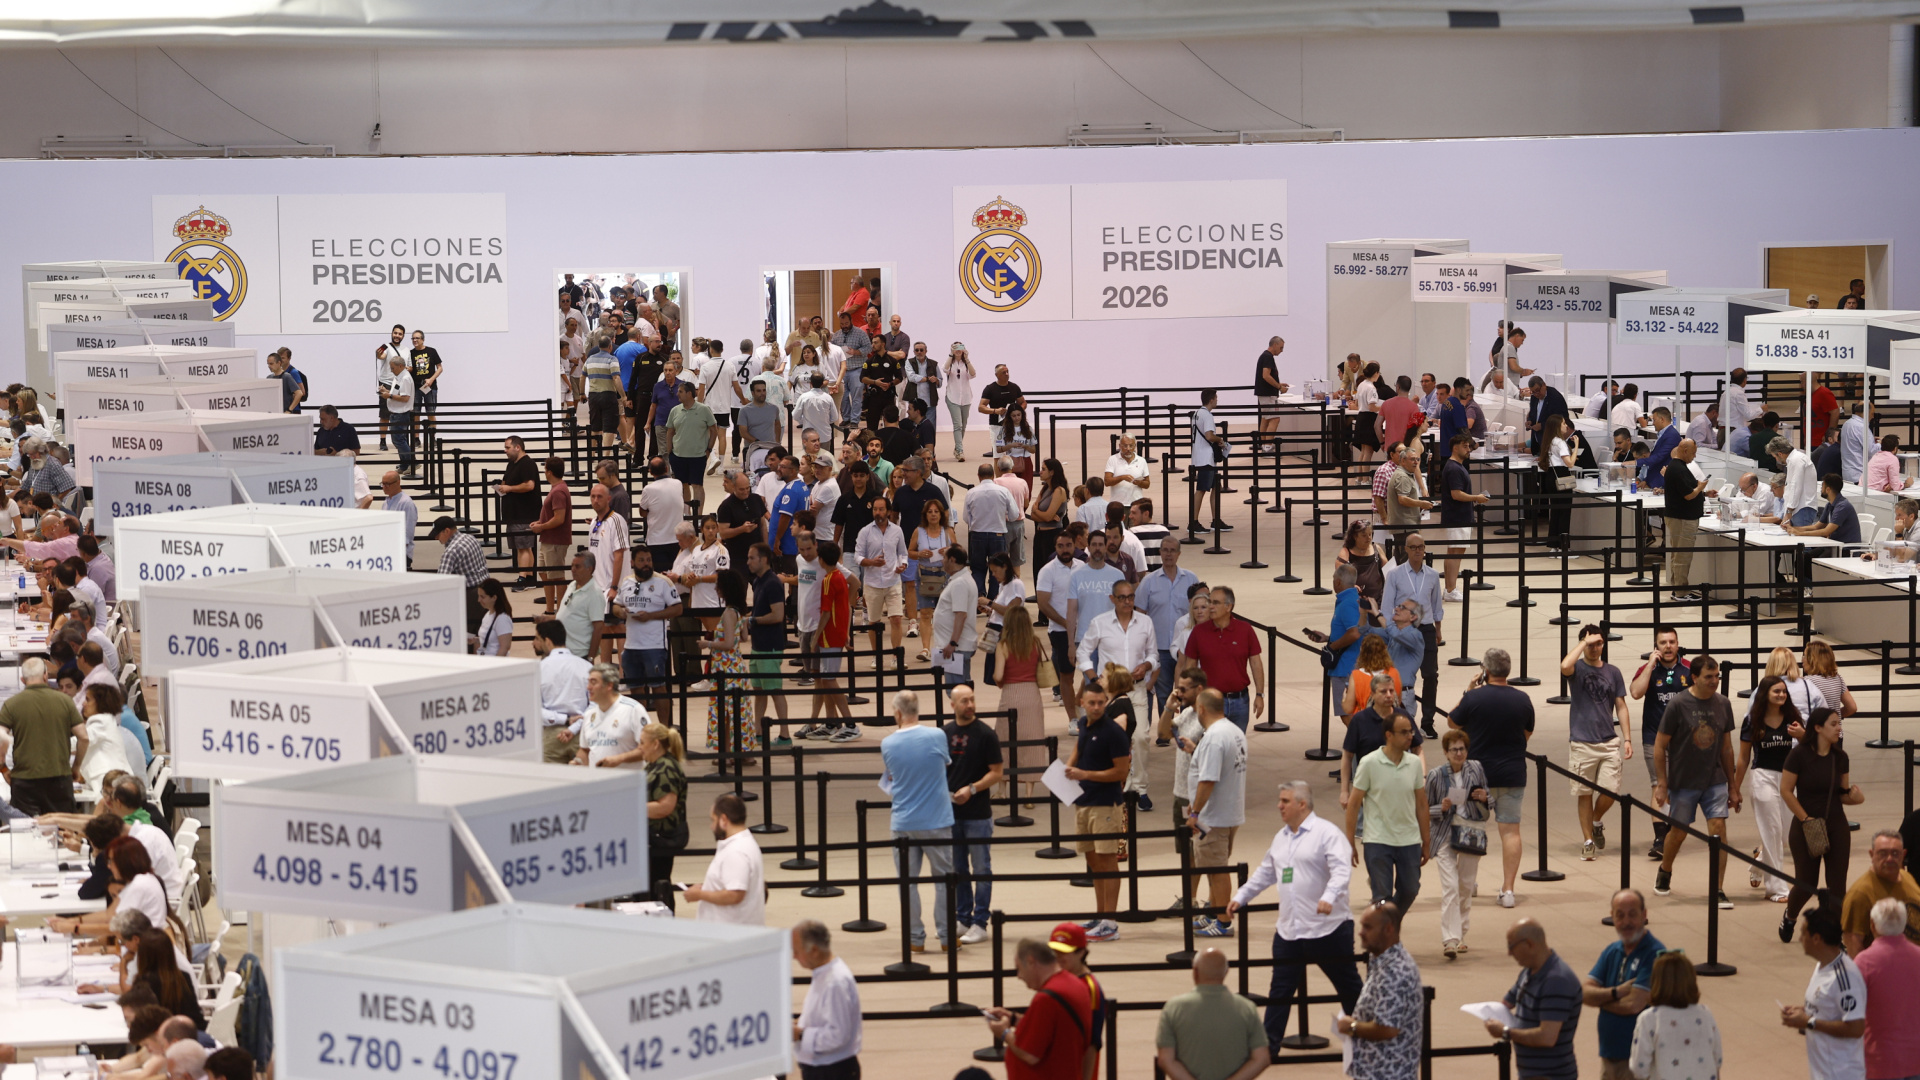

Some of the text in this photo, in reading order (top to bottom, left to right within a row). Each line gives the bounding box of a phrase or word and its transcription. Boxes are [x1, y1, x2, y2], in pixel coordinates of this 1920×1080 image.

[1102, 223, 1284, 245] ELECCIONES
[312, 237, 503, 257] ELECCIONES
[1103, 248, 1284, 272] PRESIDENCIA
[1352, 253, 1389, 262] MESA 45
[312, 262, 503, 285] PRESIDENCIA
[1333, 264, 1366, 275] 56.992
[1376, 265, 1408, 276] 58.277
[1439, 268, 1478, 277] MESA 44
[1418, 280, 1454, 291] 55.703
[1464, 281, 1497, 292] 56.991
[1538, 286, 1580, 295] MESA 43
[1102, 285, 1169, 309] 2026
[1516, 299, 1553, 311] 54.423
[1564, 300, 1602, 311] 55.702
[65, 315, 89, 323] MESA
[312, 299, 383, 323] 2026
[1649, 306, 1695, 317] MESA 42
[1626, 320, 1666, 333] 53.132
[1678, 322, 1719, 334] 54.422
[1781, 329, 1830, 340] MESA 41
[77, 338, 116, 348] MESA 12
[172, 337, 208, 346] MESA 19
[1755, 344, 1798, 358] 51.838
[1811, 346, 1854, 359] 53.131
[88, 366, 128, 378] MESA 11
[189, 364, 228, 376] MESA 20
[99, 399, 144, 412] MESA 10
[208, 396, 251, 410] MESA 21
[112, 437, 163, 451] MESA 09
[233, 434, 279, 449] MESA 22
[135, 481, 191, 497] MESA 08
[268, 478, 318, 495] MESA 23
[162, 540, 224, 557] MESA 07
[310, 536, 364, 555] MESA 24
[139, 562, 185, 581] 8.002
[193, 609, 263, 630] MESA 06
[360, 603, 421, 627] MESA 25
[168, 634, 219, 657] 6.706
[239, 639, 287, 659] 8.001
[398, 625, 452, 650] 32.579
[231, 699, 311, 724] MESA 05
[421, 692, 490, 720] MESA 26
[466, 716, 526, 749] 33.854
[202, 728, 259, 755] 5.416
[282, 734, 341, 762] 6.705
[287, 820, 382, 850] MESA 04
[510, 810, 589, 845] MESA 27
[561, 838, 627, 876] 35.141
[253, 853, 322, 886] 4.098
[349, 862, 418, 895] 5.415
[629, 979, 722, 1024] MESA 28
[360, 993, 475, 1031] MESA 03
[688, 1010, 770, 1059] 36.420
[318, 1032, 402, 1072] 2.780
[433, 1045, 518, 1080] 4.097
